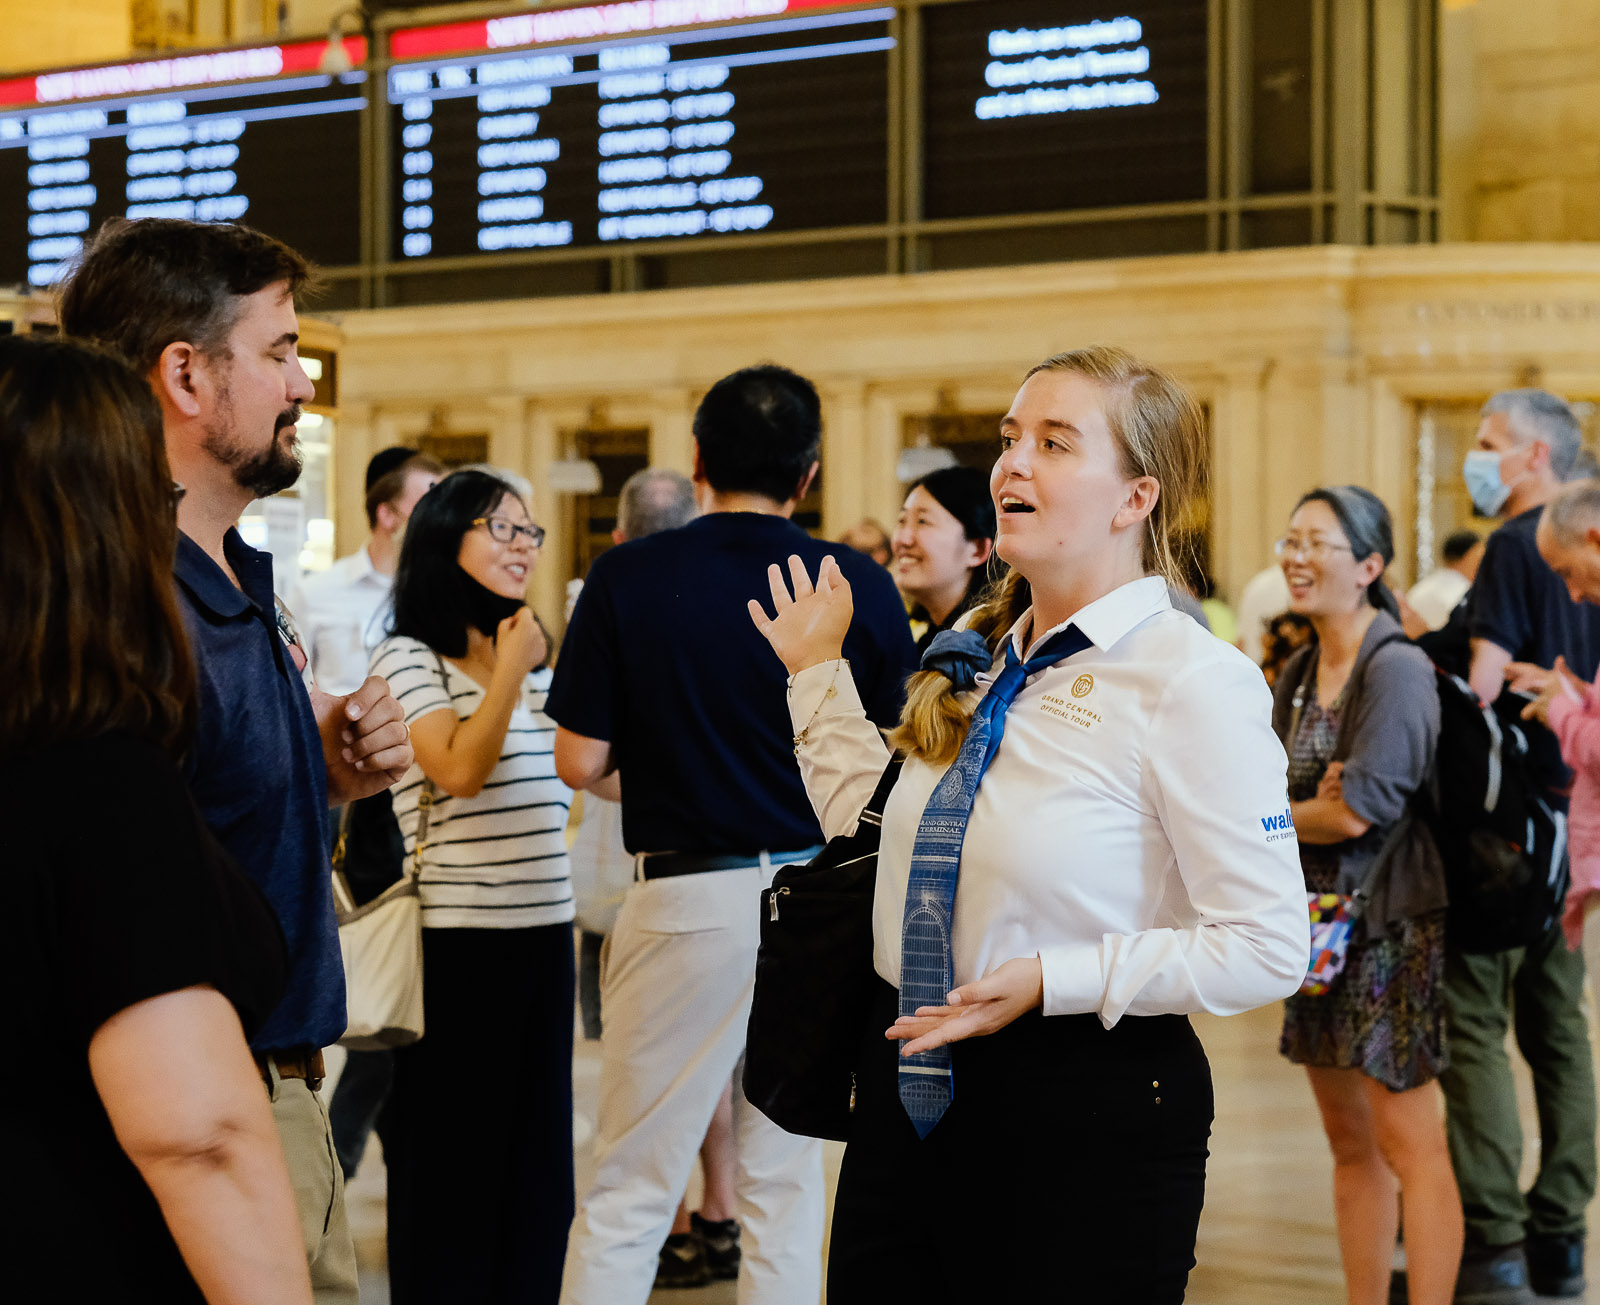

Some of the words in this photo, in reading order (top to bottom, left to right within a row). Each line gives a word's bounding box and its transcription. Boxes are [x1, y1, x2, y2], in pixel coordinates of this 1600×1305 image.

[1040, 704, 1069, 719] OFFICIAL
[1070, 715, 1091, 728] TOUR
[1041, 695, 1064, 705] GRAND
[1066, 702, 1102, 722] CENTRAL
[1266, 835, 1279, 843] CITY
